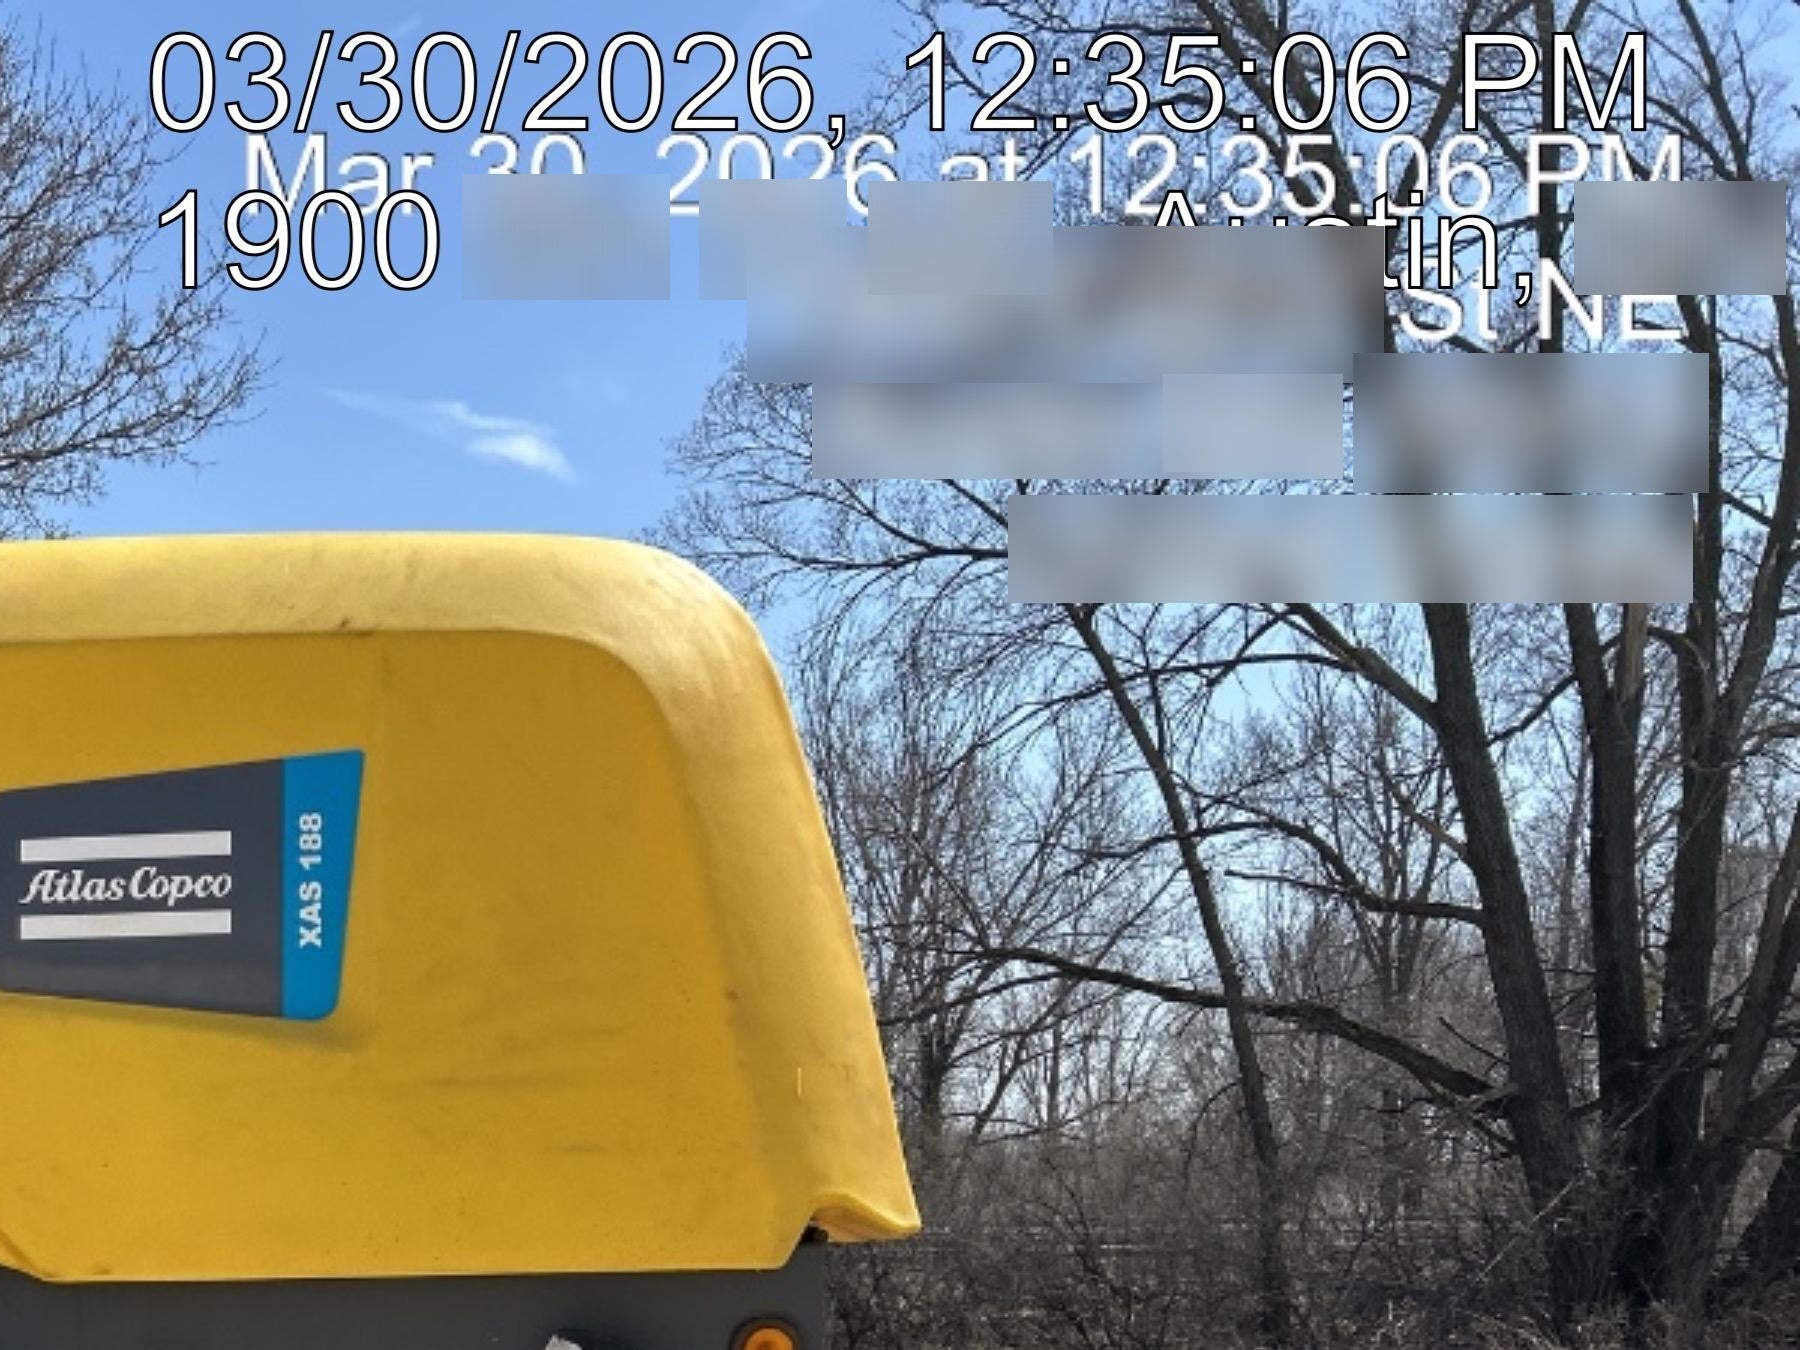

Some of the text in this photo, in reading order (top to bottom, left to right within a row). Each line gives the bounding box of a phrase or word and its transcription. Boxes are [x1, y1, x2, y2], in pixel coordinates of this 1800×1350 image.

[19, 866, 232, 906] Atlas Copco
[299, 812, 322, 948] XAS 188
